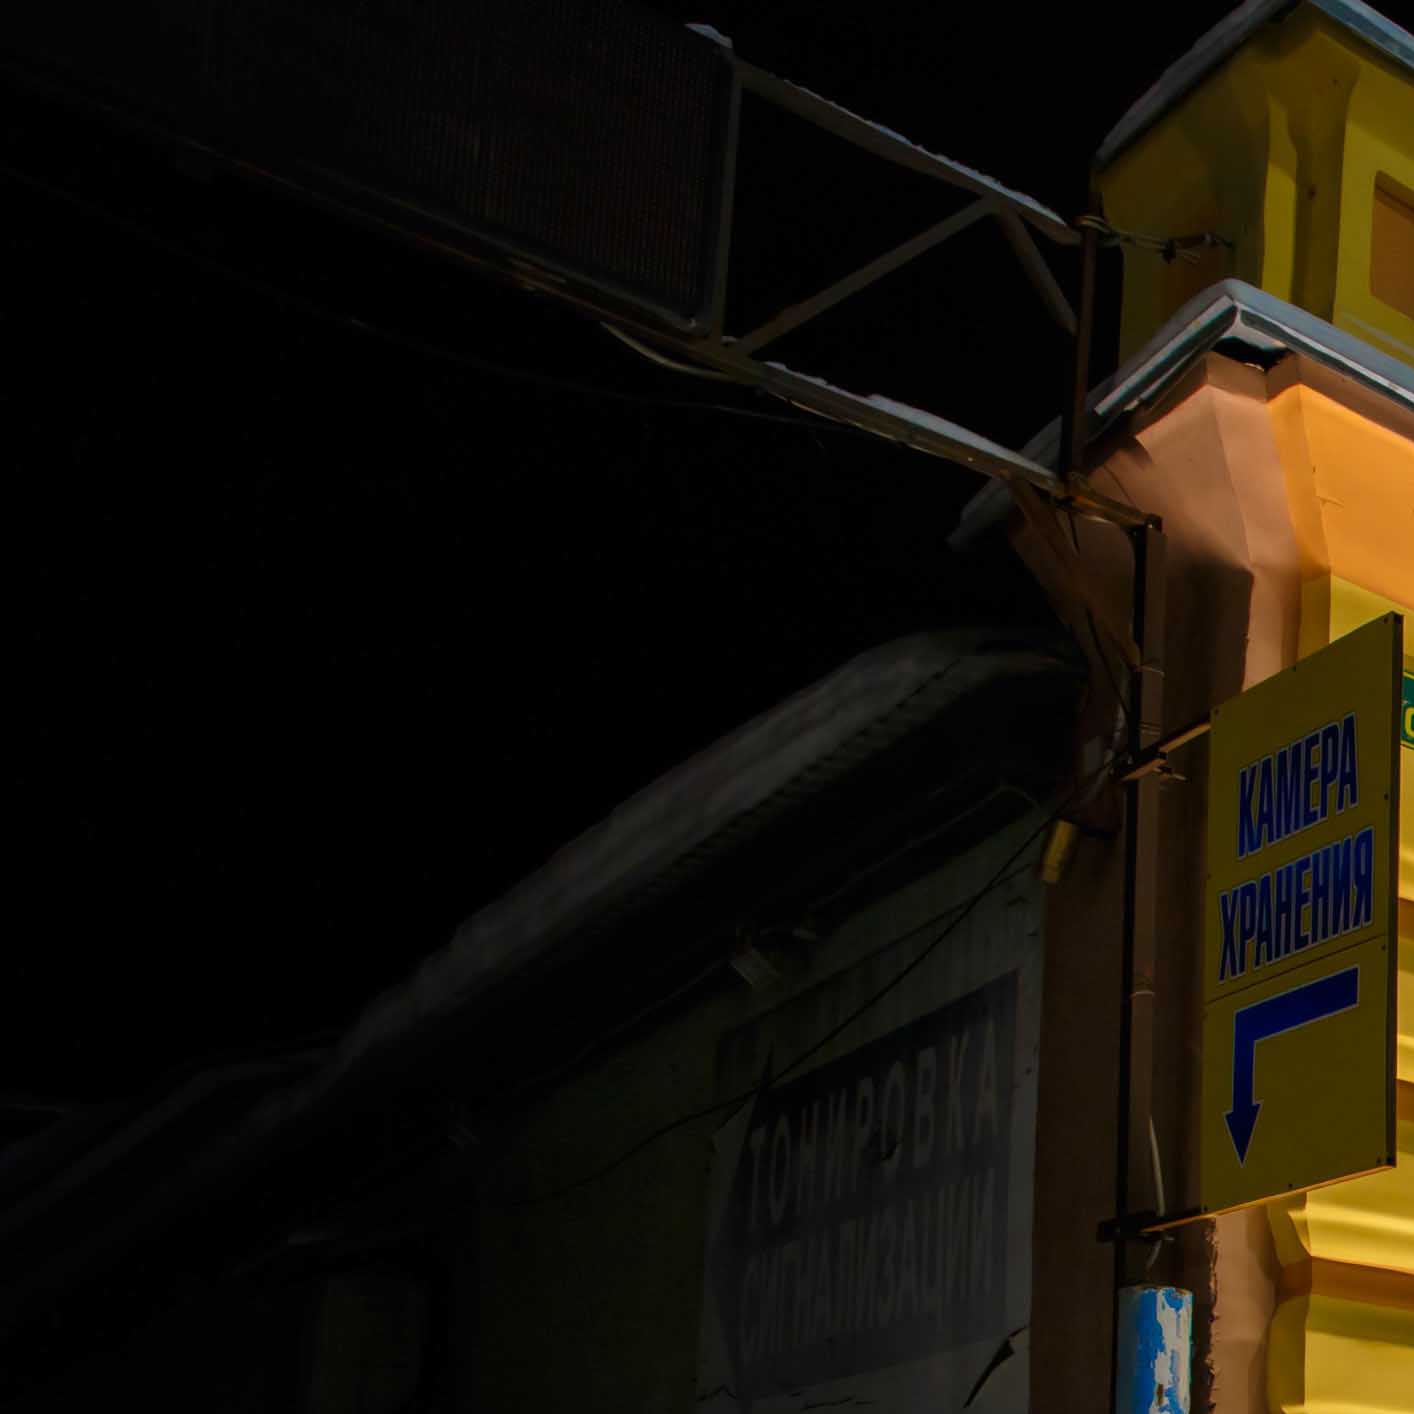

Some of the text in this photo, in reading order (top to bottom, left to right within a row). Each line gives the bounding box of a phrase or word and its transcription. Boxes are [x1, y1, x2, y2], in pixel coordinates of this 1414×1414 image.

[1236, 712, 1360, 860] КАМЕРА
[1217, 826, 1375, 982] ХРАНЕНИЯ
[746, 1016, 1002, 1230] ТОНИРОВКА
[738, 1166, 997, 1364] СИГНАЛИЗАЦИИ
